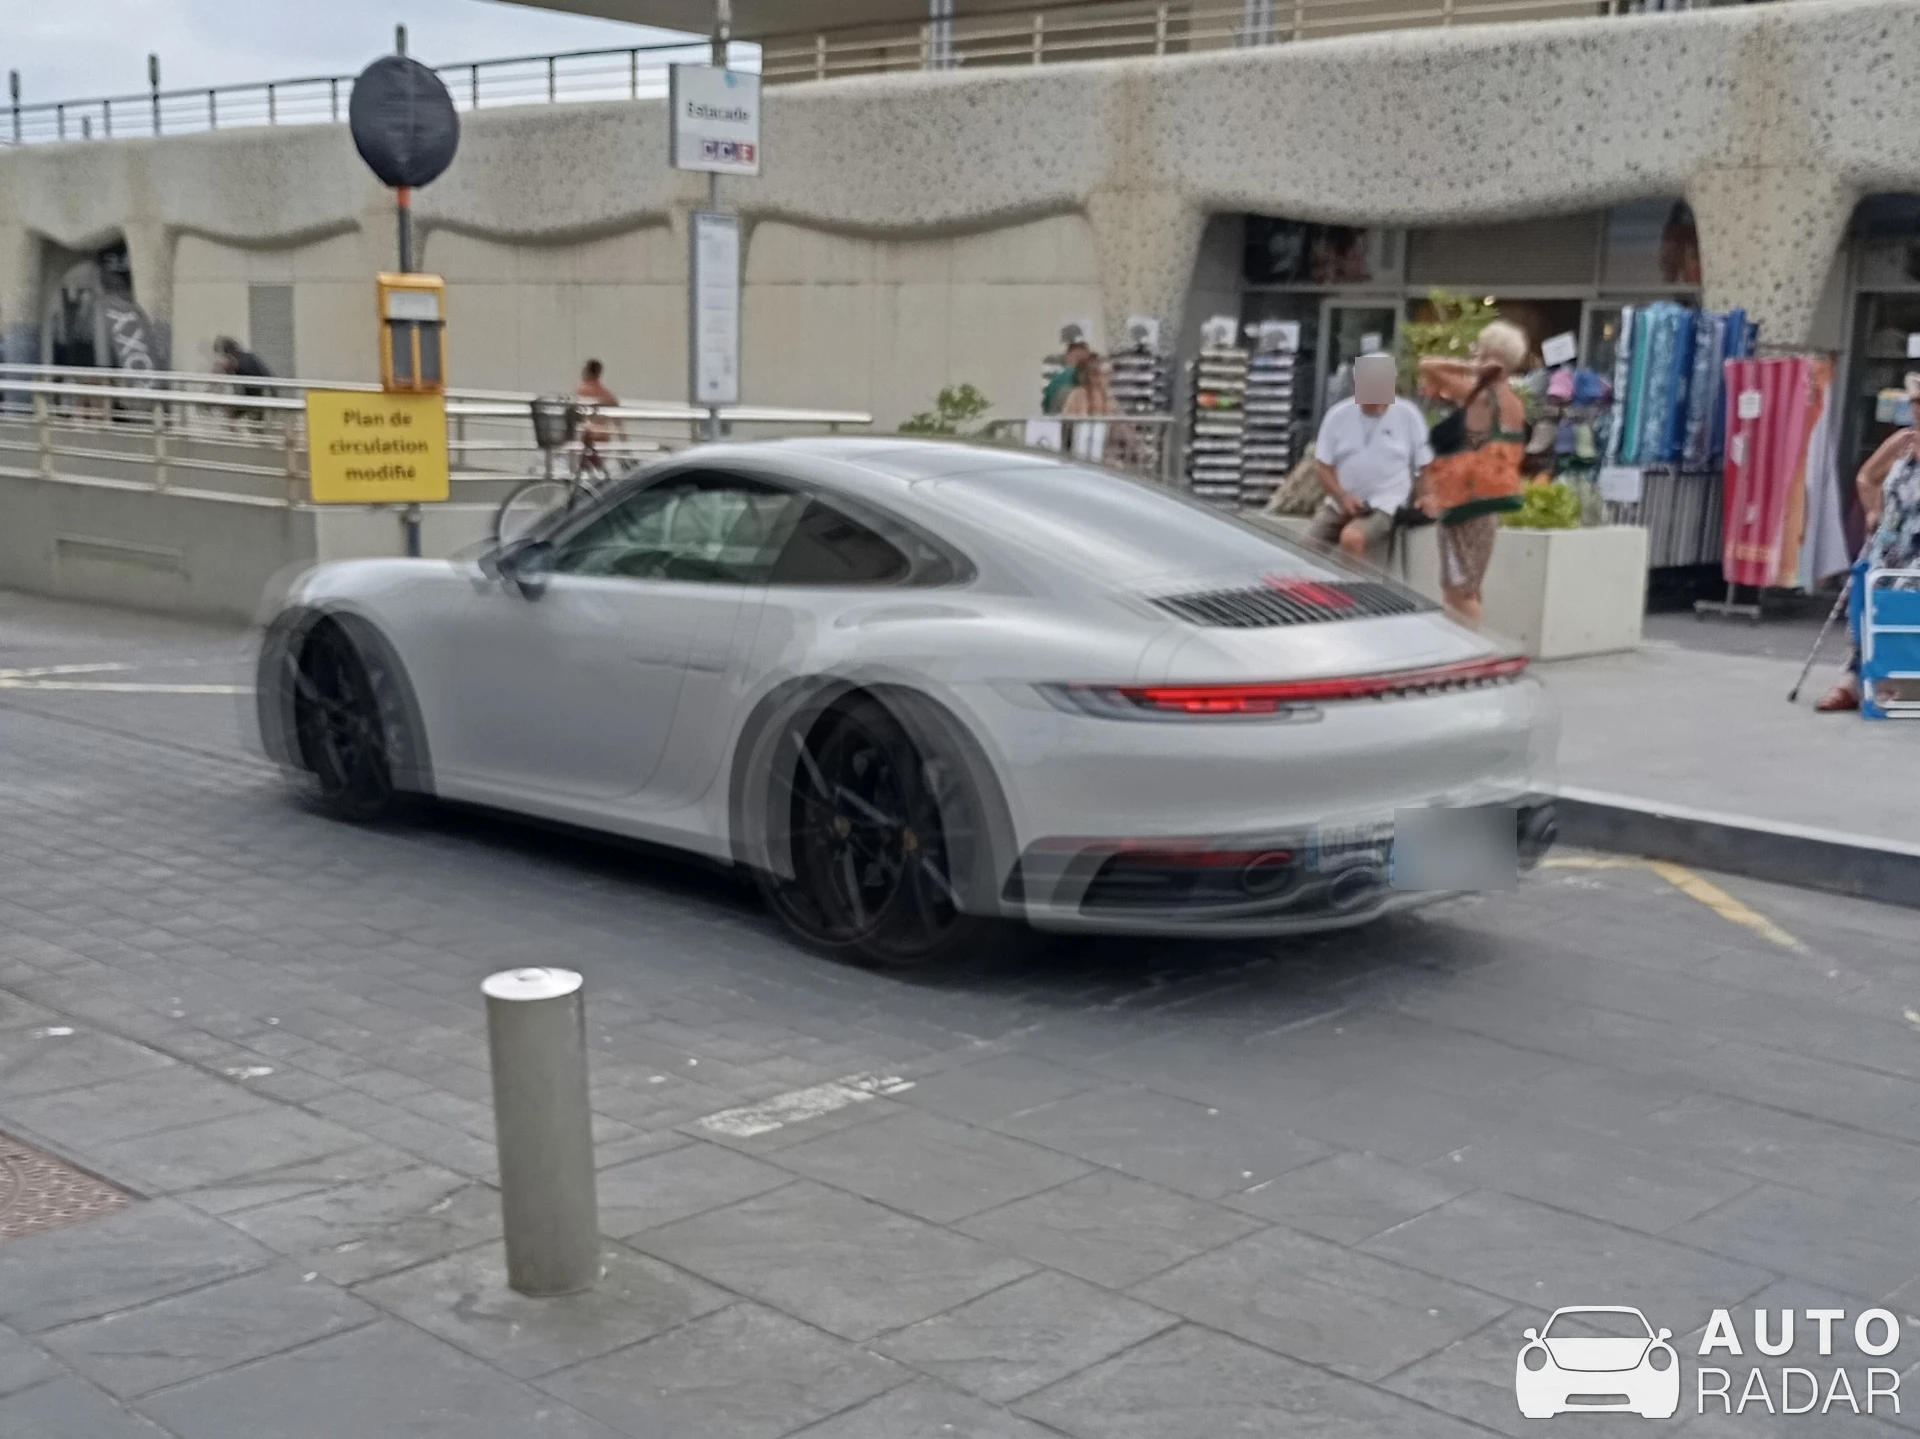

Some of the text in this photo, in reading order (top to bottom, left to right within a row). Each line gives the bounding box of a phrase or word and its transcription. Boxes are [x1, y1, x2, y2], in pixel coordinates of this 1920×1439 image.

[343, 409, 413, 427] Plan de
[329, 437, 429, 454] circulation
